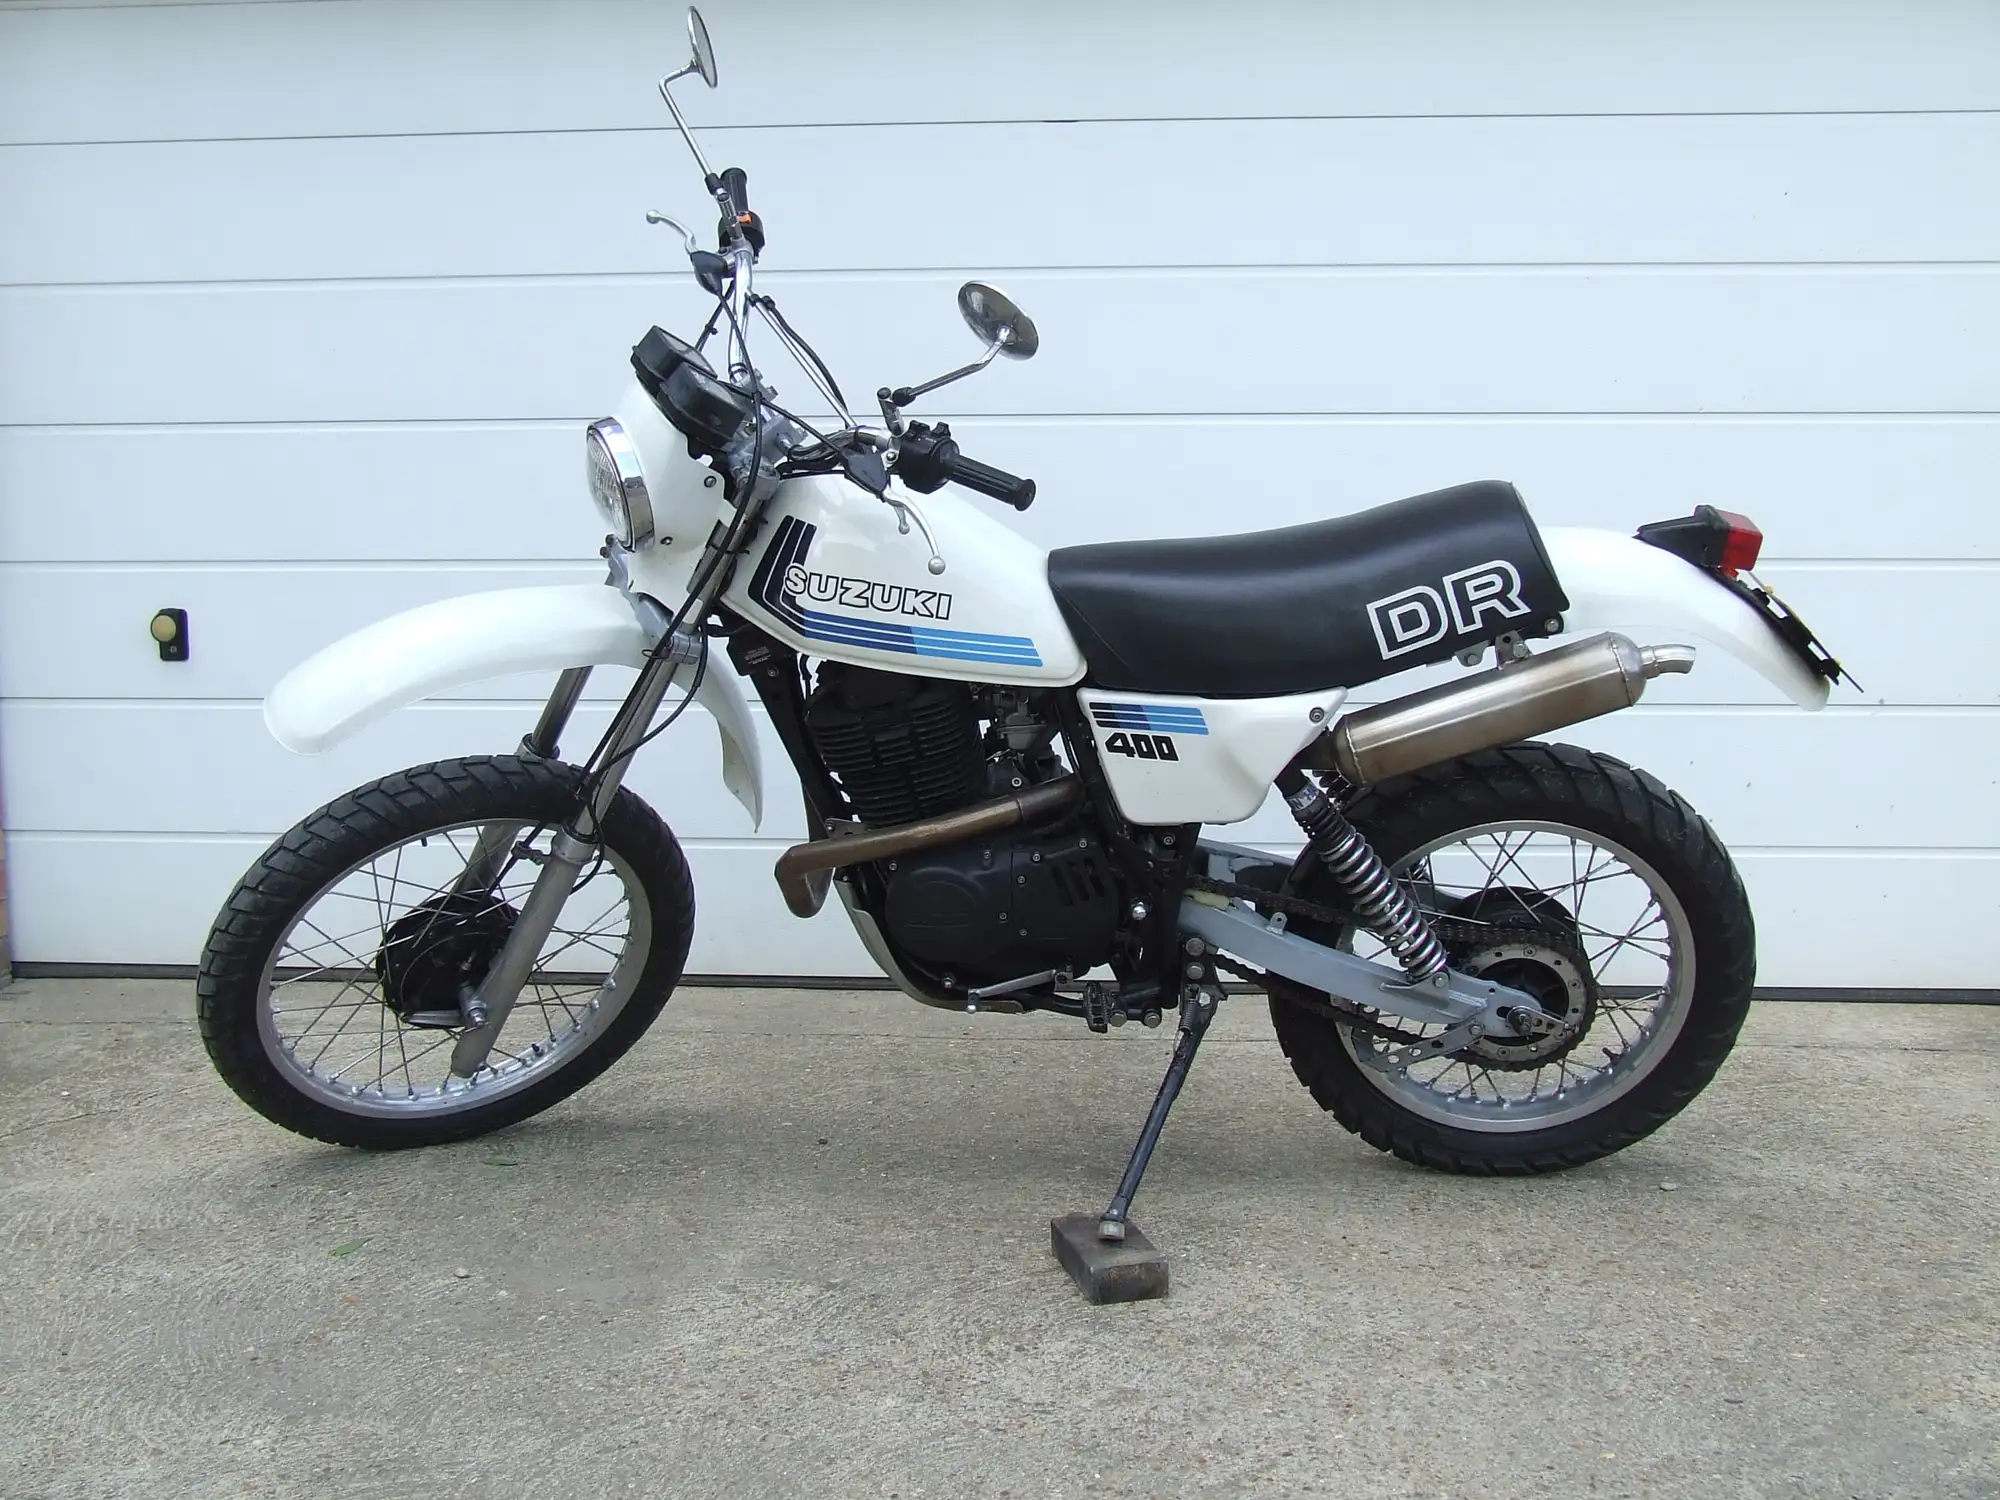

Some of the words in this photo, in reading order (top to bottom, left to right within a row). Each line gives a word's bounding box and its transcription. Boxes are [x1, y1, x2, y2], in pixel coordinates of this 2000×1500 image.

[784, 563, 953, 620] SUZUKI
[1366, 560, 1531, 660] DR
[1105, 732, 1179, 762] 400
